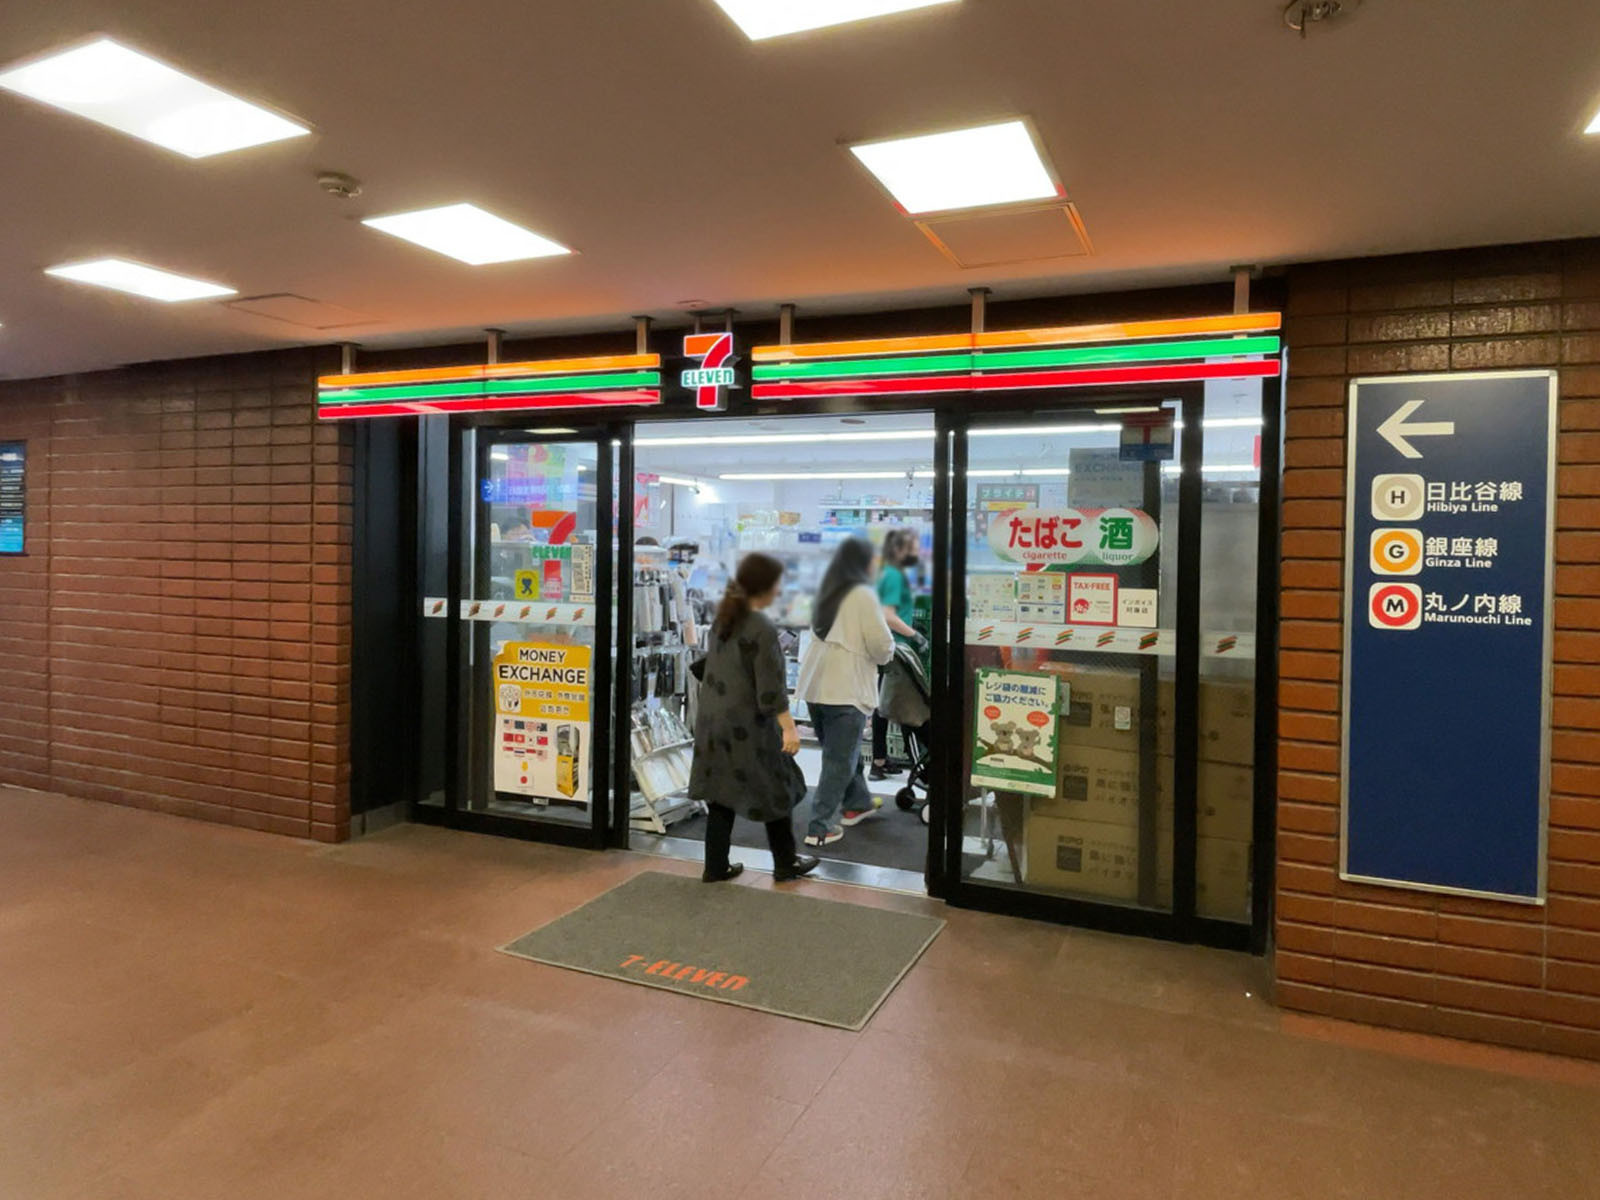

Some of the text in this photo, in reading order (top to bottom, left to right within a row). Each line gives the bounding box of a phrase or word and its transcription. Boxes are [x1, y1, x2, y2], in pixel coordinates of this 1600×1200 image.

[1391, 490, 1405, 504] H
[1427, 481, 1523, 501] 日比谷線
[1427, 502, 1498, 514] Hibiya Line
[1008, 515, 1083, 549] たばこ
[1099, 517, 1134, 549] 酒
[1388, 544, 1405, 559] G
[1425, 537, 1498, 557] 銀座線
[1023, 551, 1134, 562] cigarette liquor
[1425, 558, 1492, 568] Ginza Line
[1386, 598, 1405, 613] M
[1424, 592, 1522, 613] 丸ノ内線
[1424, 613, 1533, 626] Marunouchi Line
[519, 649, 566, 663] MONEY
[498, 665, 586, 684] EXCHANGE
